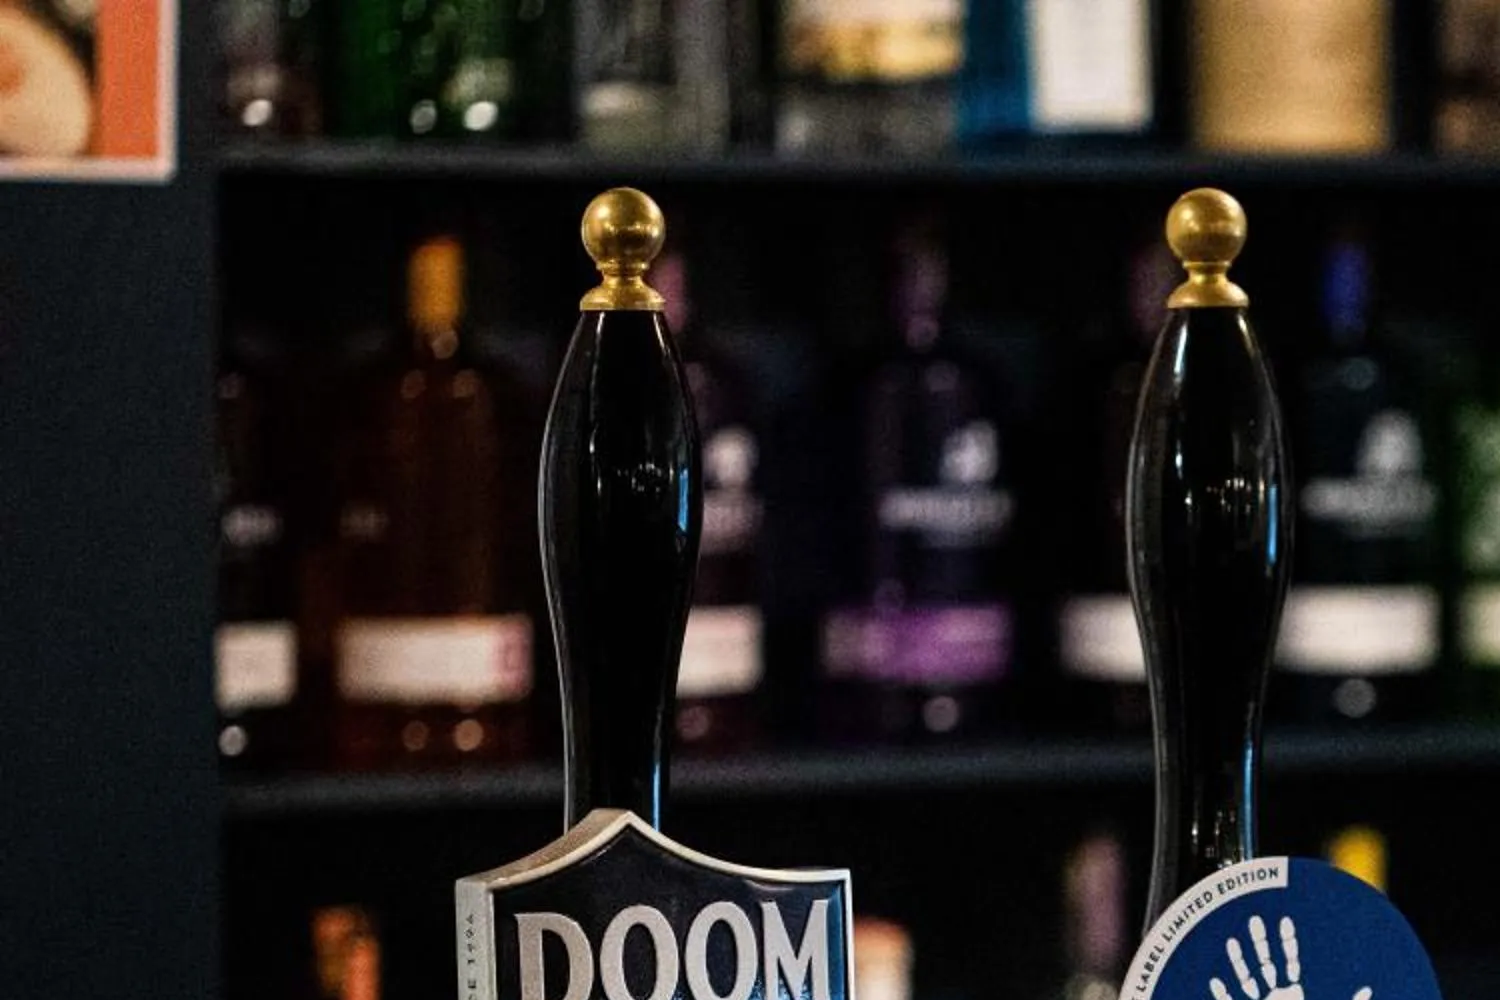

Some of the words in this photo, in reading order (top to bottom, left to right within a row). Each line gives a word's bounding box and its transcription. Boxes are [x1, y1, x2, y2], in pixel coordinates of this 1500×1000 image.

[1136, 944, 1166, 992] LABEL
[1165, 891, 1214, 942] LIMITED
[1217, 868, 1281, 896] EDITION
